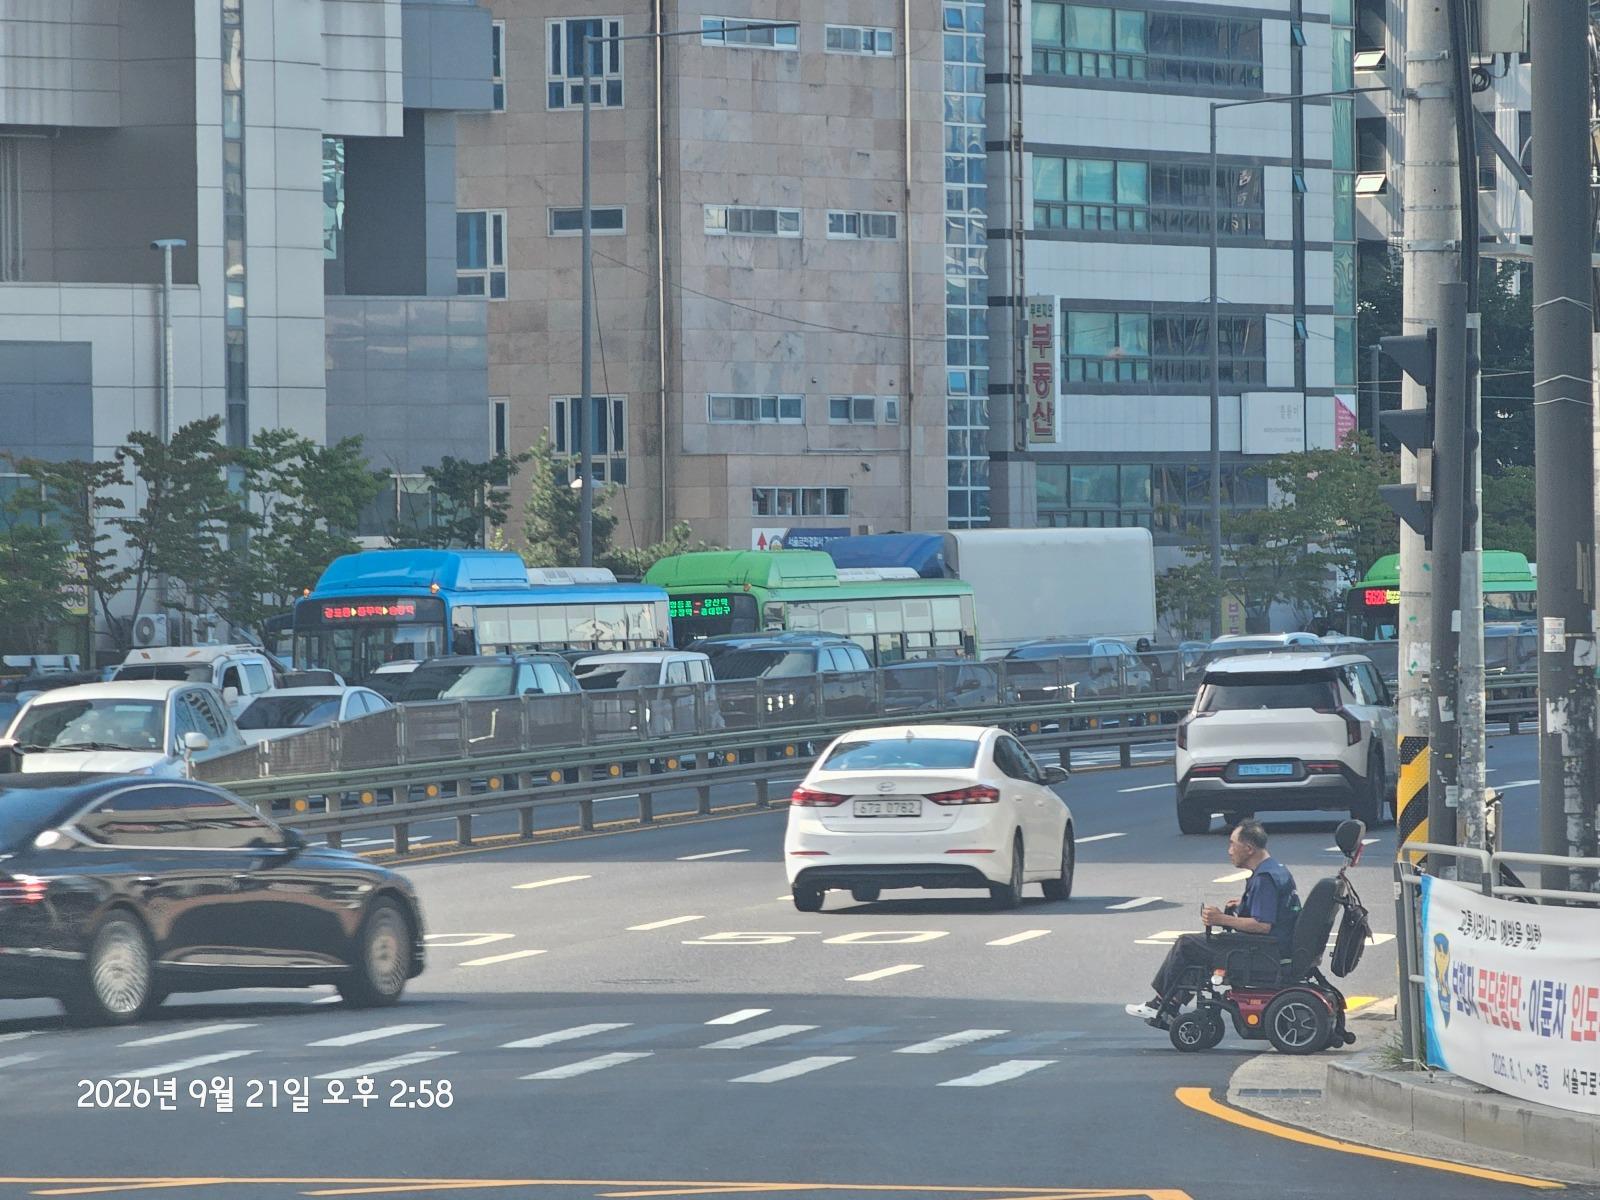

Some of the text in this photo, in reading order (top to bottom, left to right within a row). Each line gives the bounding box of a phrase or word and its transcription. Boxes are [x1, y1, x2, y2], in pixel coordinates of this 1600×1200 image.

[1032, 324, 1053, 436] 부동산
[1457, 909, 1542, 950] 교통사망사고 예방을 위한
[1452, 960, 1479, 1020] 보행자
[1570, 984, 1600, 1042] 인도
[1562, 1067, 1600, 1096] 서울구로
